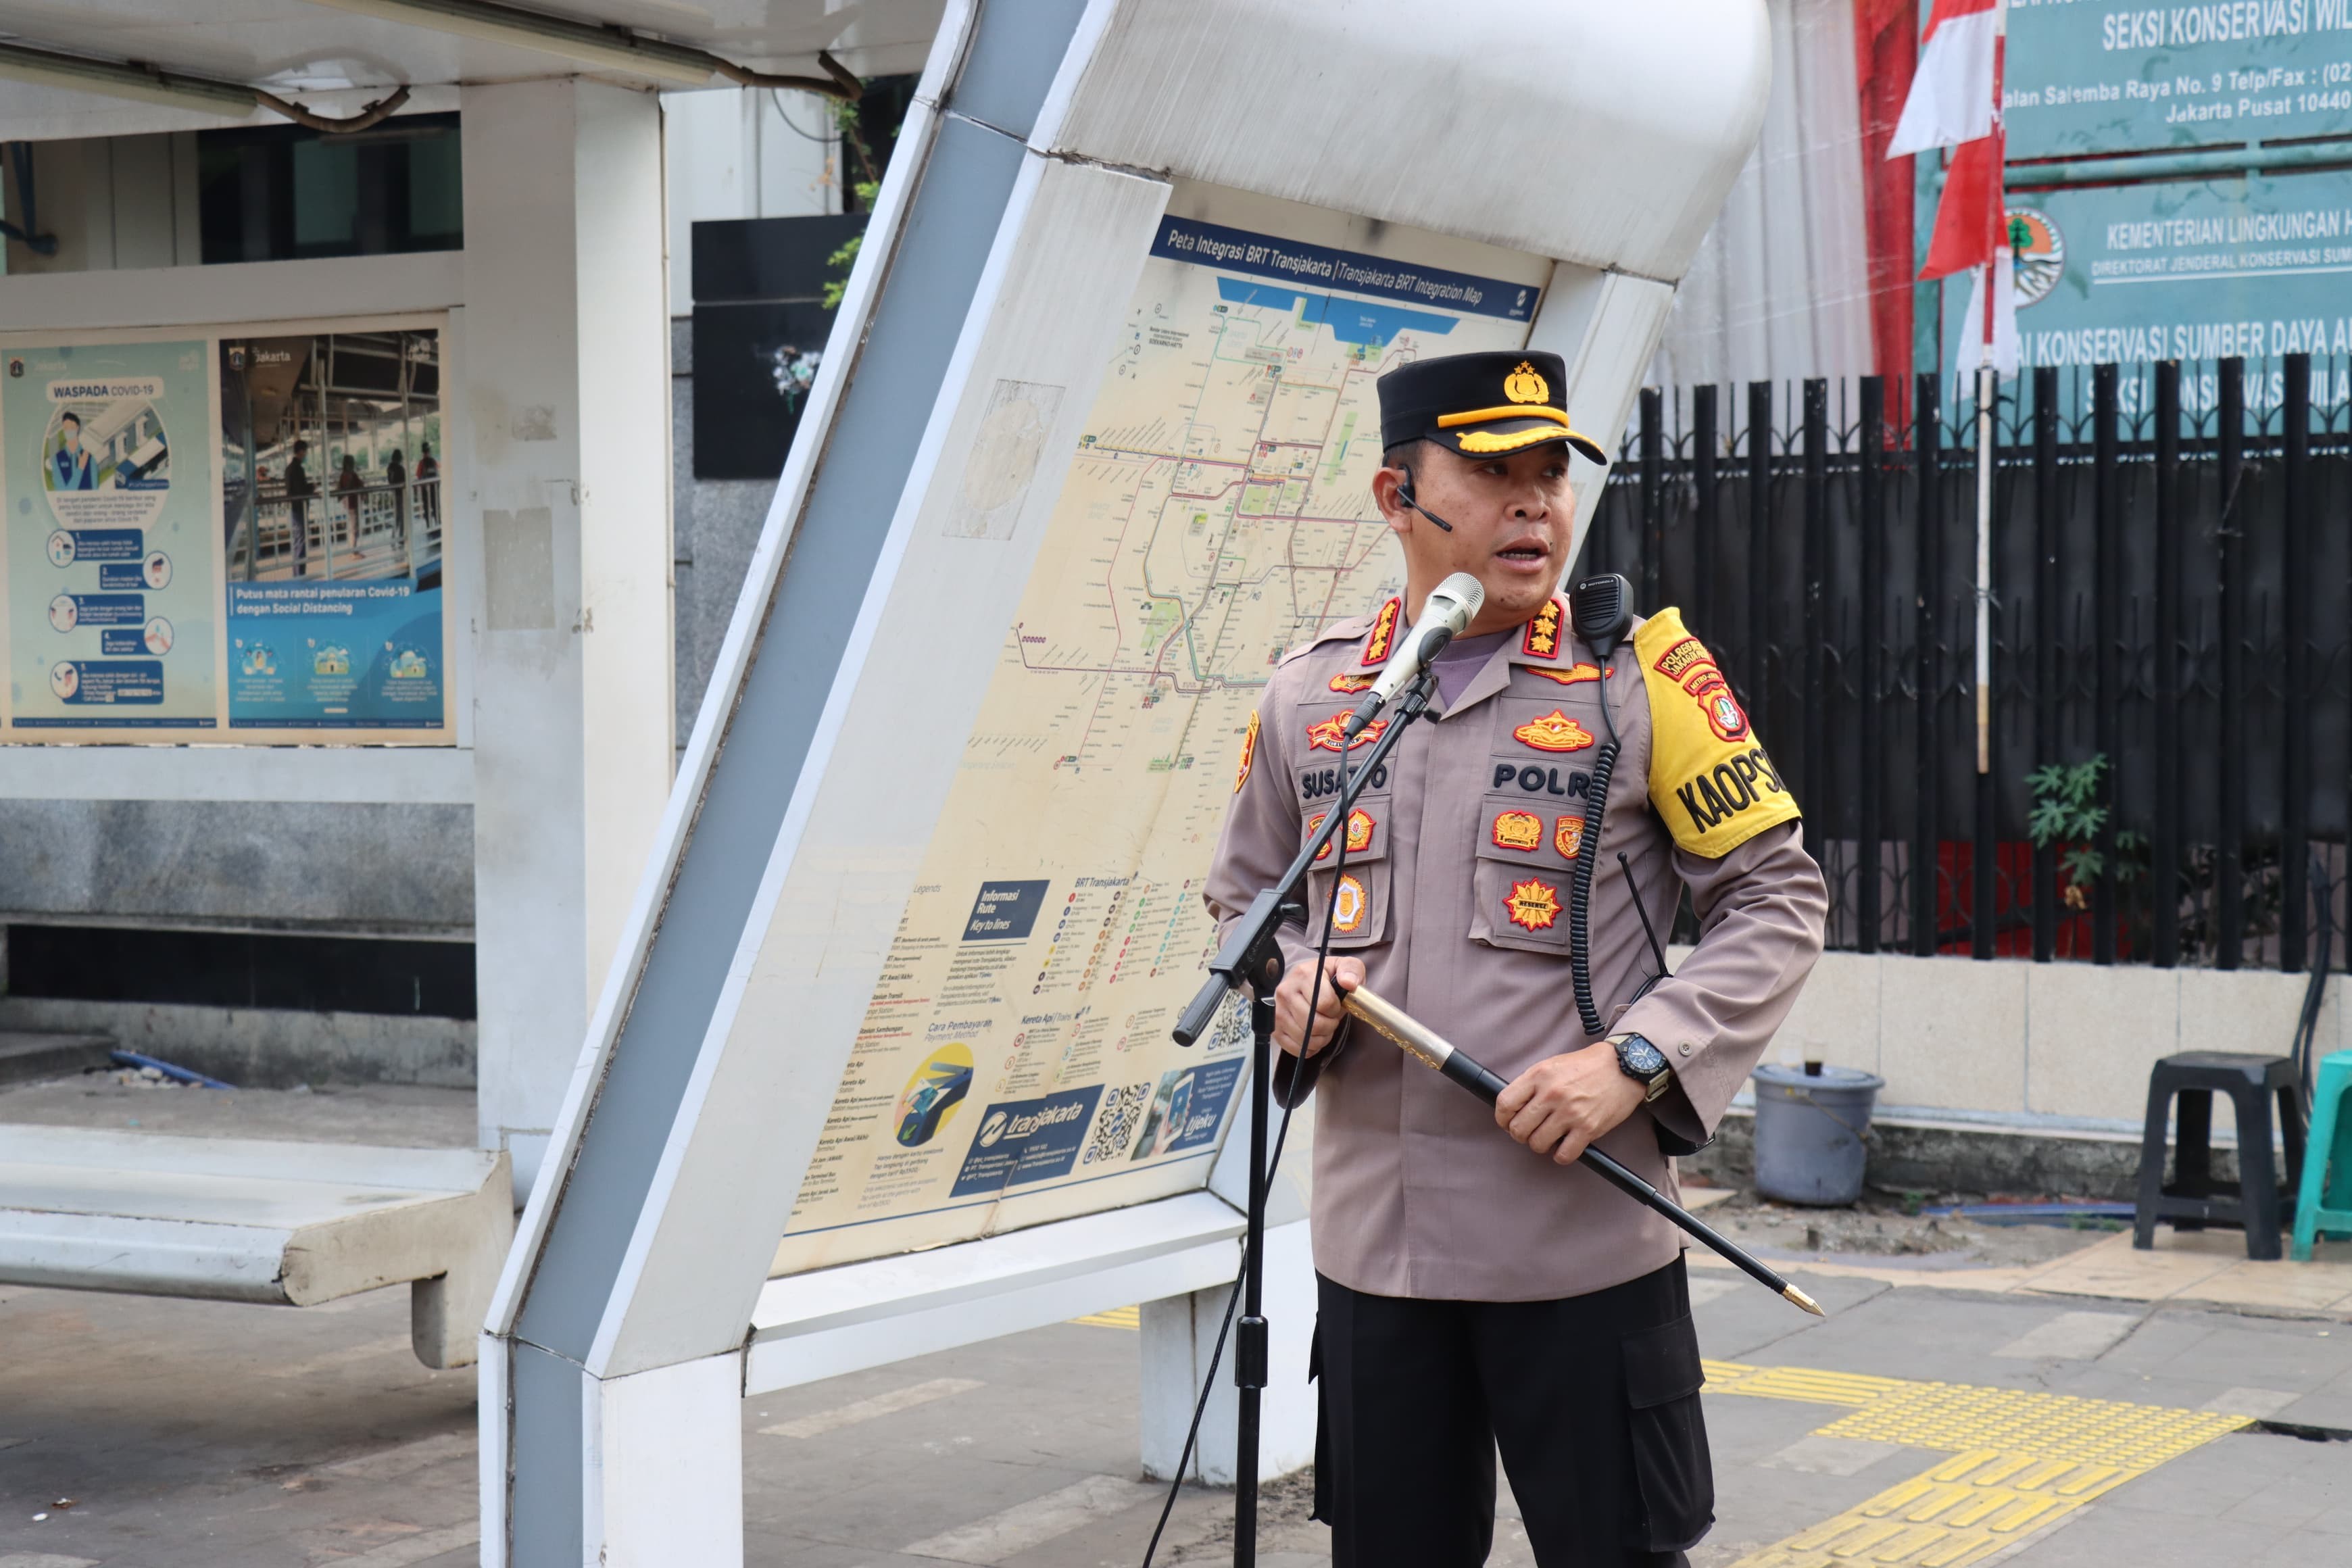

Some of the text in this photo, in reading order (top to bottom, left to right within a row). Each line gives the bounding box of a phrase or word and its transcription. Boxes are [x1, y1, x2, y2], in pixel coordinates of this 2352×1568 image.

[2103, 11, 2165, 51] SEKSI
[2170, 1, 2309, 45] KONSERVASI
[2003, 91, 2040, 109] alan
[2044, 82, 2120, 105] Salemba
[2126, 78, 2170, 102] Raya
[2176, 75, 2206, 95] No.
[2211, 72, 2222, 92] 9
[2228, 67, 2305, 91] Telp/Fax
[2166, 92, 2351, 124] Jakarta Pusat 10440
[2107, 218, 2224, 251] KEMENTERIAN
[2228, 210, 2341, 244] LINGKUNGAN
[1167, 229, 1483, 307] Peta Integrasi BRT Transjakarta Transjakarta BRT Integration Map
[2092, 259, 2168, 276] DIREKTORAT
[2172, 255, 2236, 272] JENDERAL
[2239, 249, 2321, 268] KONSERVASI
[2036, 326, 2169, 366] KONSERVASI
[2173, 321, 2265, 361] SUMBER
[2271, 318, 2329, 357] DAYA
[53, 385, 154, 398] WASPADA COVID-19
[1588, 579, 1614, 587] MOTOROLA
[237, 585, 410, 600] Putus mata rantai penularan Covid-19
[237, 602, 353, 616] dengan Social Distancing
[1661, 642, 1693, 670] POLRES
[914, 884, 941, 894] Legends
[1075, 877, 1130, 889] BRT Transjakarta
[981, 889, 1020, 903] Informasi
[977, 903, 996, 914] Rute
[970, 918, 1012, 933] Key to lines
[928, 1019, 992, 1032] Cara Pembayaran
[1021, 1014, 1042, 1025] Kereta
